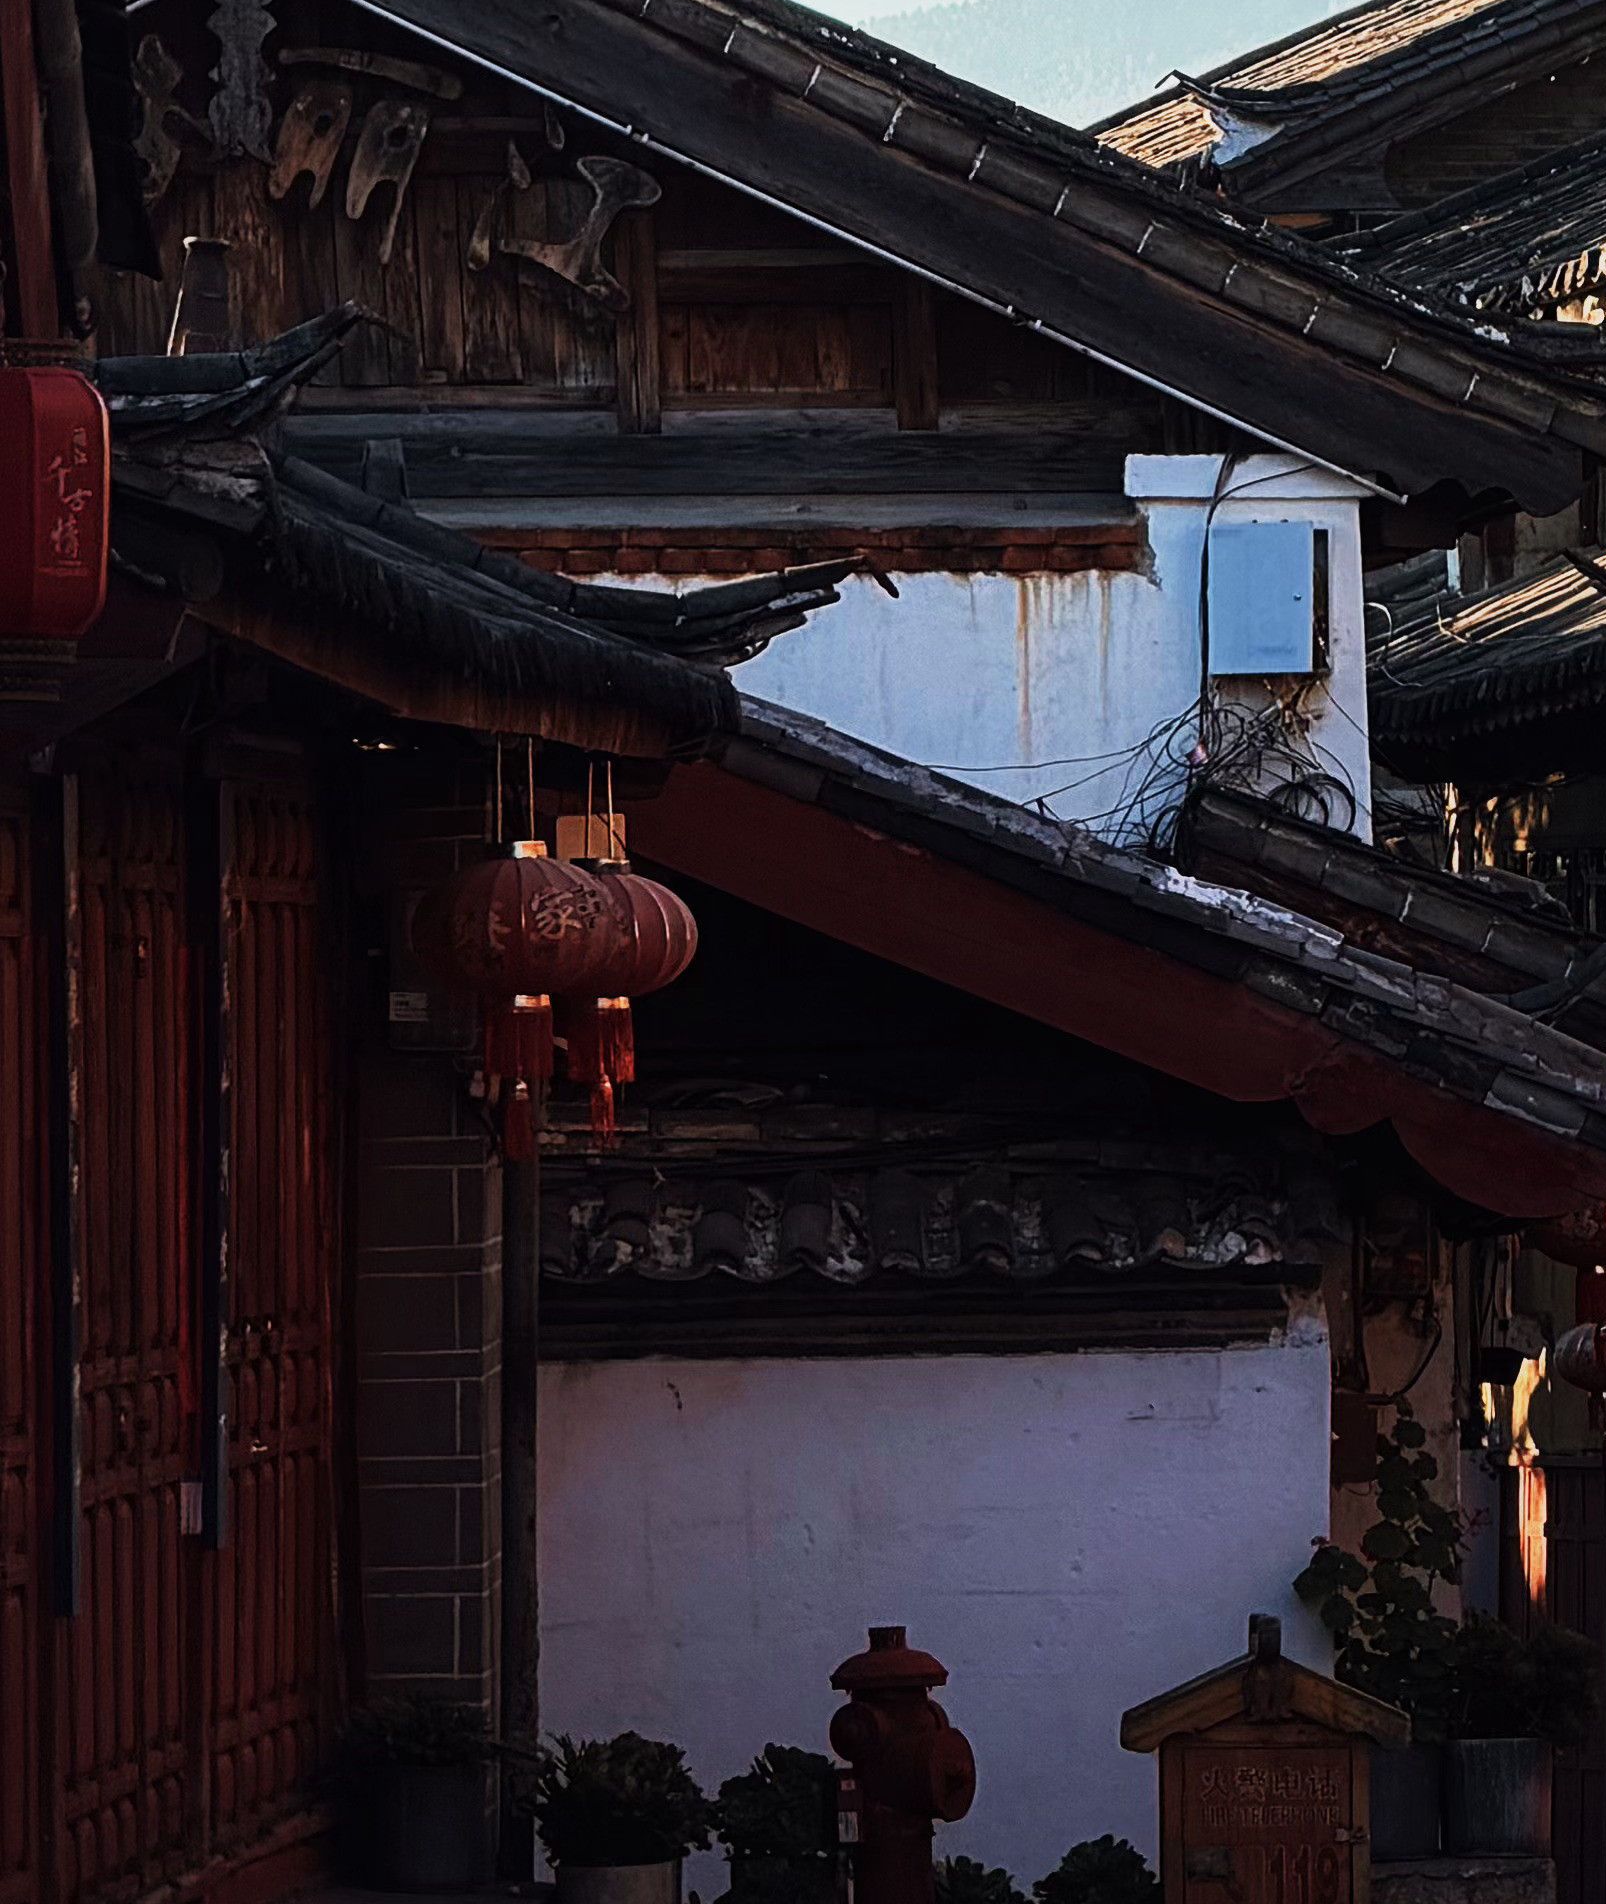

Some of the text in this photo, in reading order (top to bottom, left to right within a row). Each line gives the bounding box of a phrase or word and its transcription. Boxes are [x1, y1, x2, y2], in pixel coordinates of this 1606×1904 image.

[1201, 1766, 1340, 1802] 火警电话
[1201, 1805, 1340, 1825] FIRE TELEPHONE
